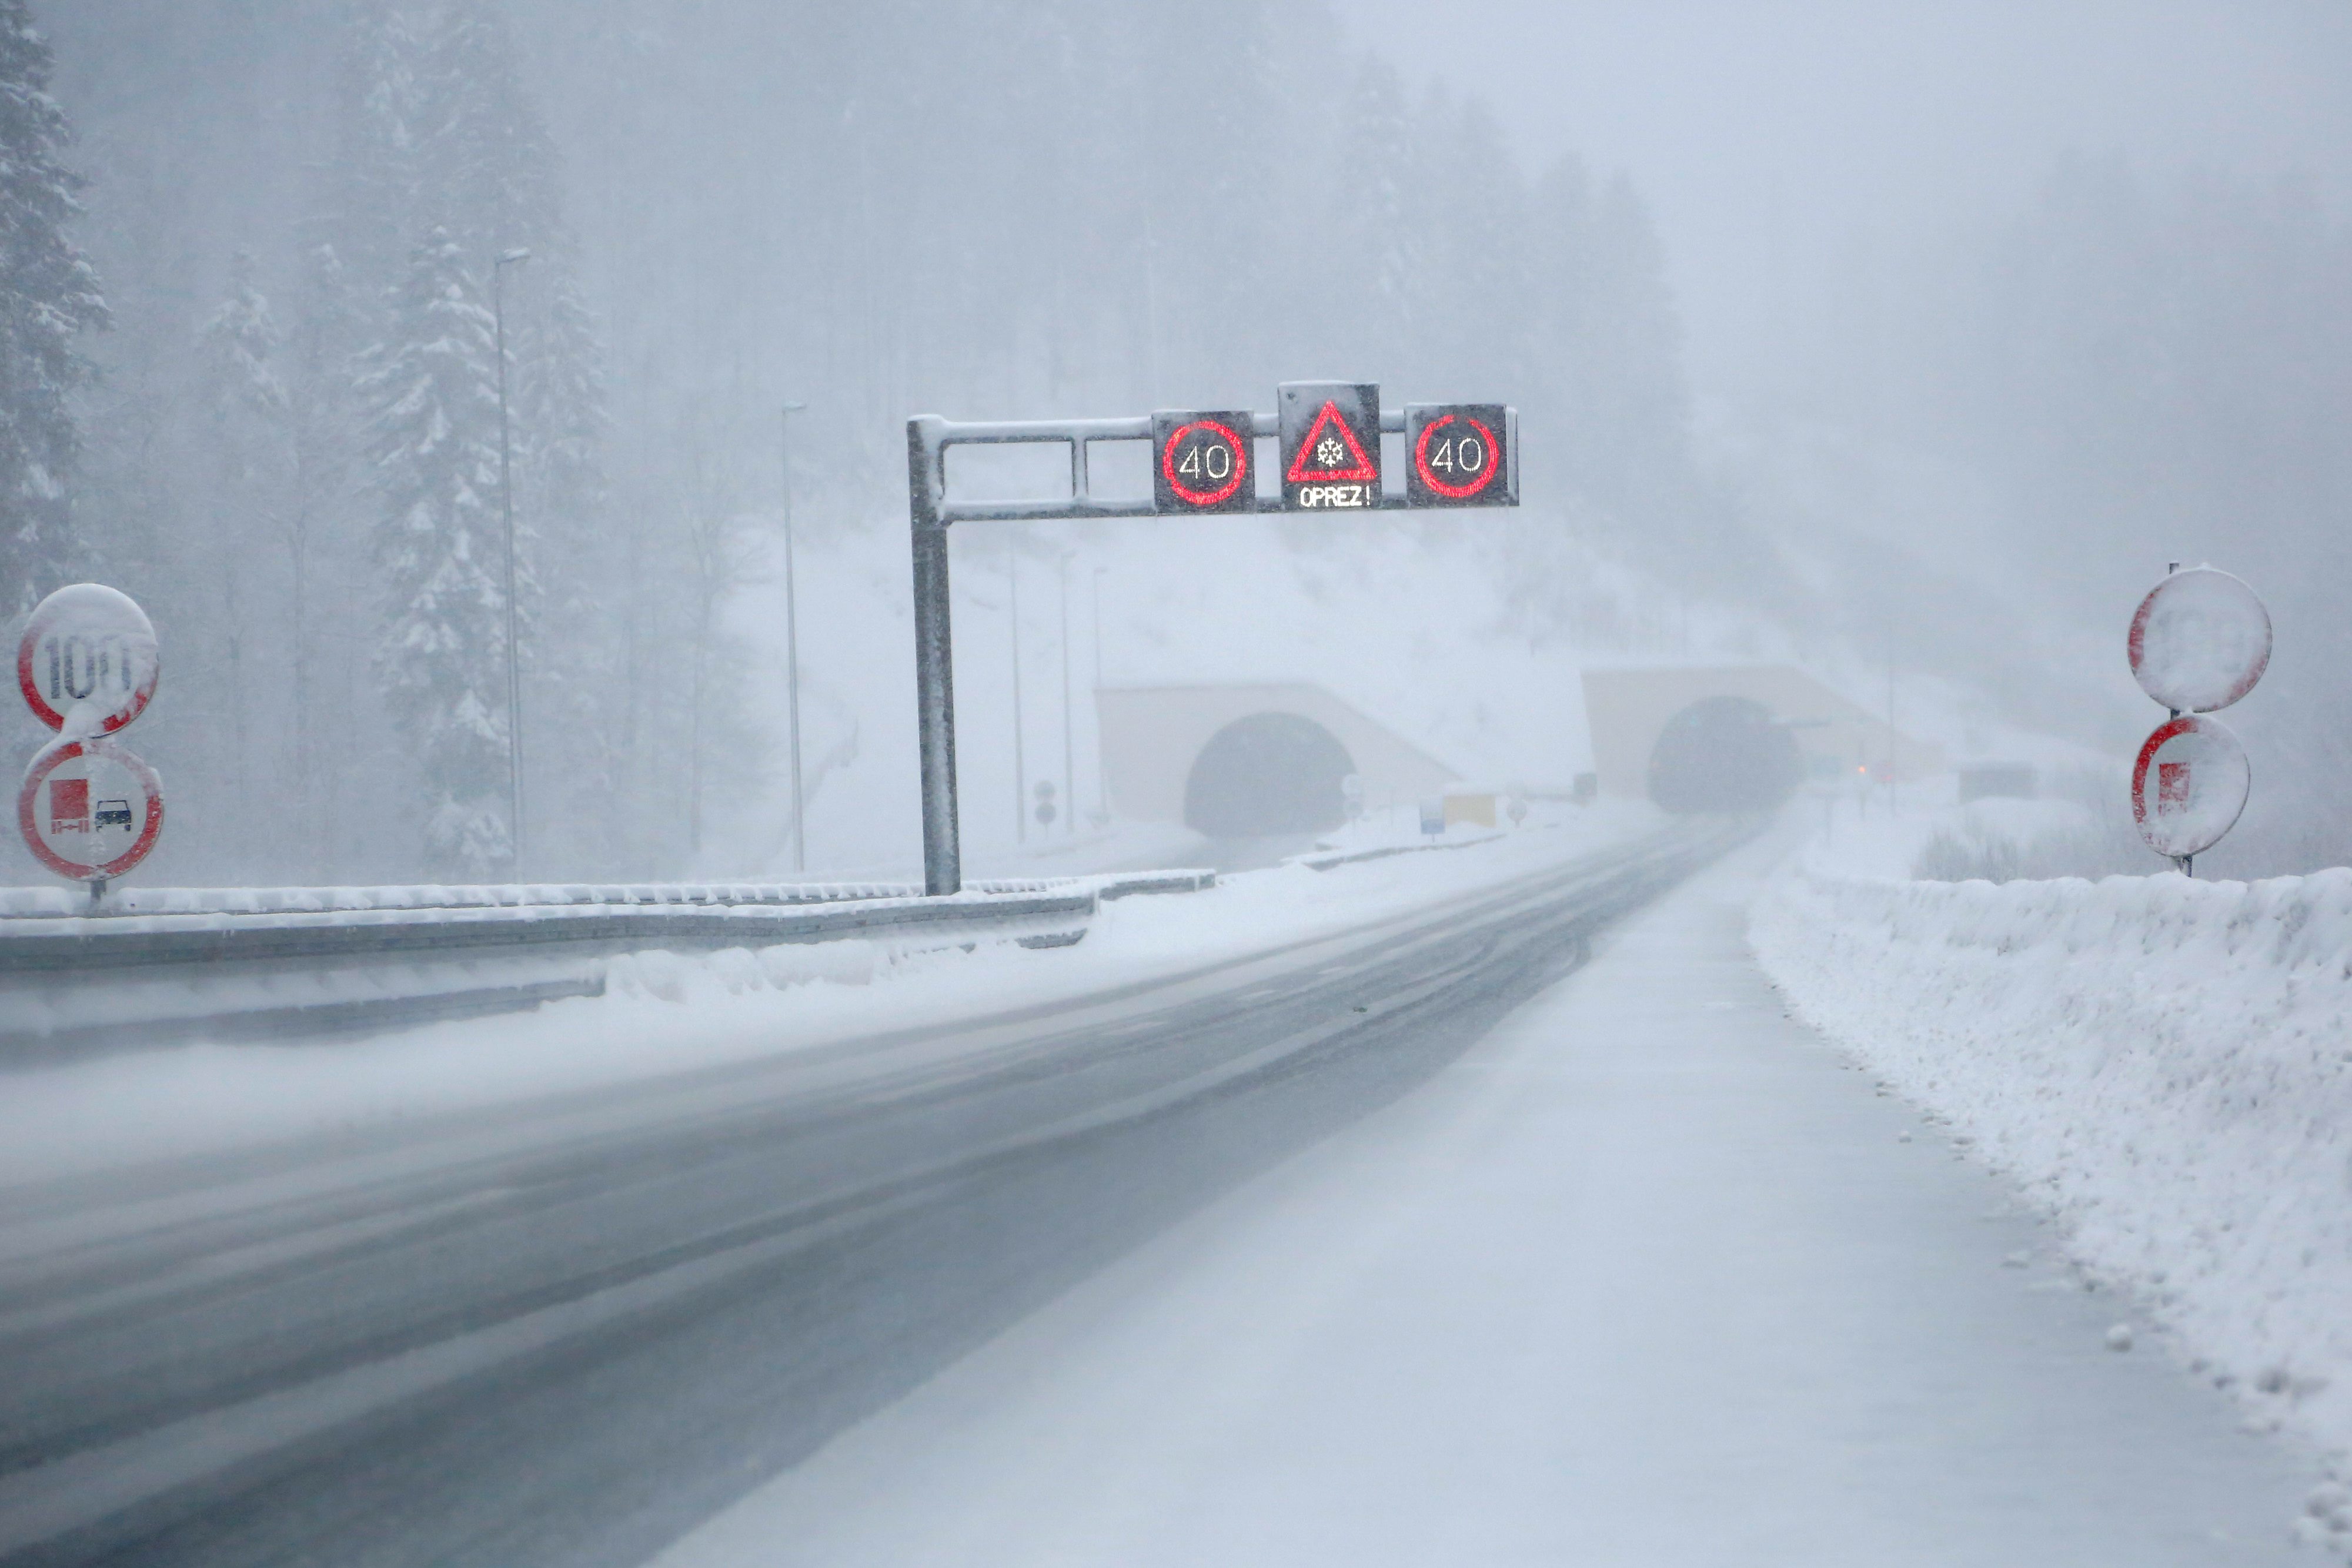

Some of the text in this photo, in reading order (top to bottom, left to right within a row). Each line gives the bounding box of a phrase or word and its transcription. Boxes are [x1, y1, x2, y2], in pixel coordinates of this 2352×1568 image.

[1179, 446, 1229, 479] 40
[1431, 437, 1481, 473] 40
[1300, 485, 1370, 507] OPREZ!
